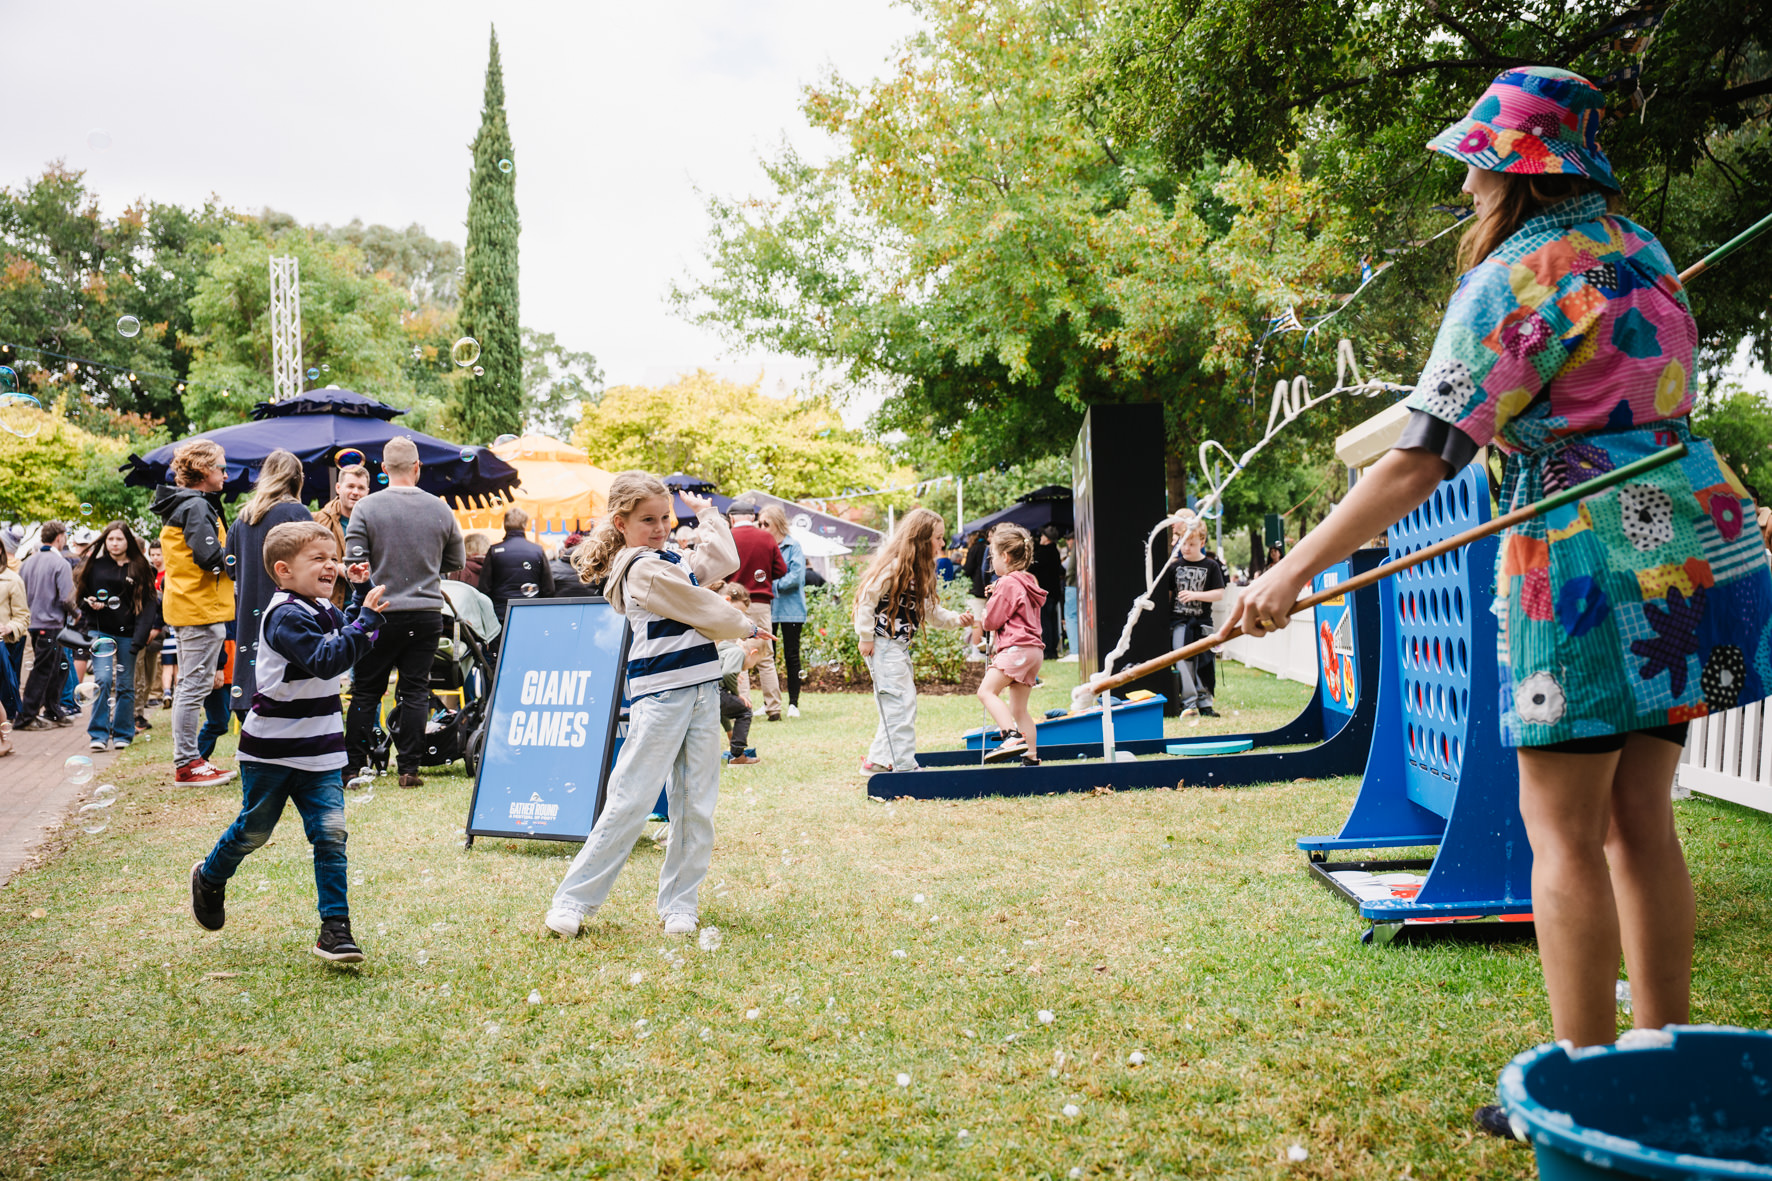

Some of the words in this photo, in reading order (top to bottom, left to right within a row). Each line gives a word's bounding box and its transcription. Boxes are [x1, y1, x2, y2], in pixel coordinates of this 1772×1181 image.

[521, 670, 592, 705] GIANT
[508, 711, 589, 748] GAMES
[509, 802, 535, 815] GATHER
[534, 803, 559, 817] ROUND
